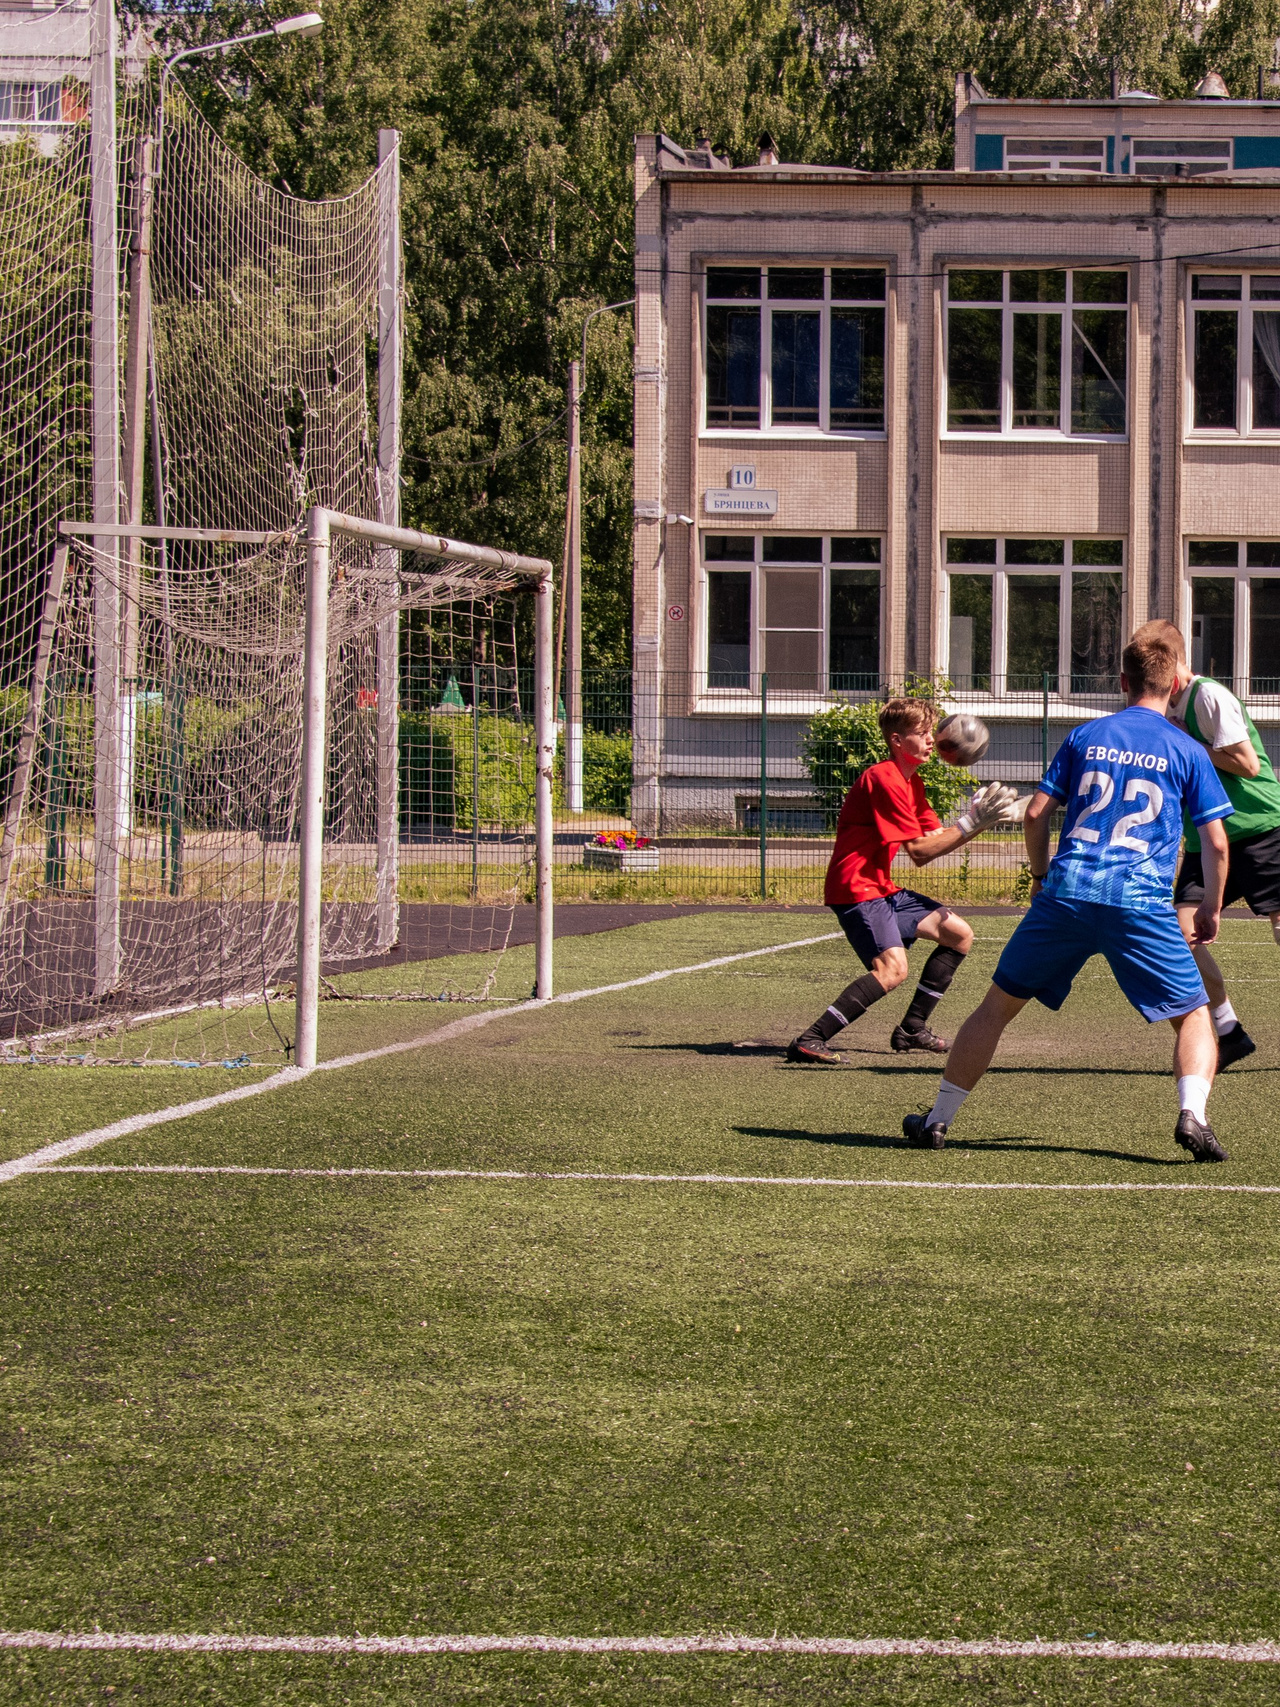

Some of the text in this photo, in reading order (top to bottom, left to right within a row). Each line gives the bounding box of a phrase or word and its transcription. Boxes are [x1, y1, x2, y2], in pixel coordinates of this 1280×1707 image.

[735, 470, 753, 485] 10
[714, 500, 770, 509] БРЯНЦЕВА
[1085, 746, 1168, 773] ЕВСЮКОВ
[1065, 770, 1164, 854] 22
